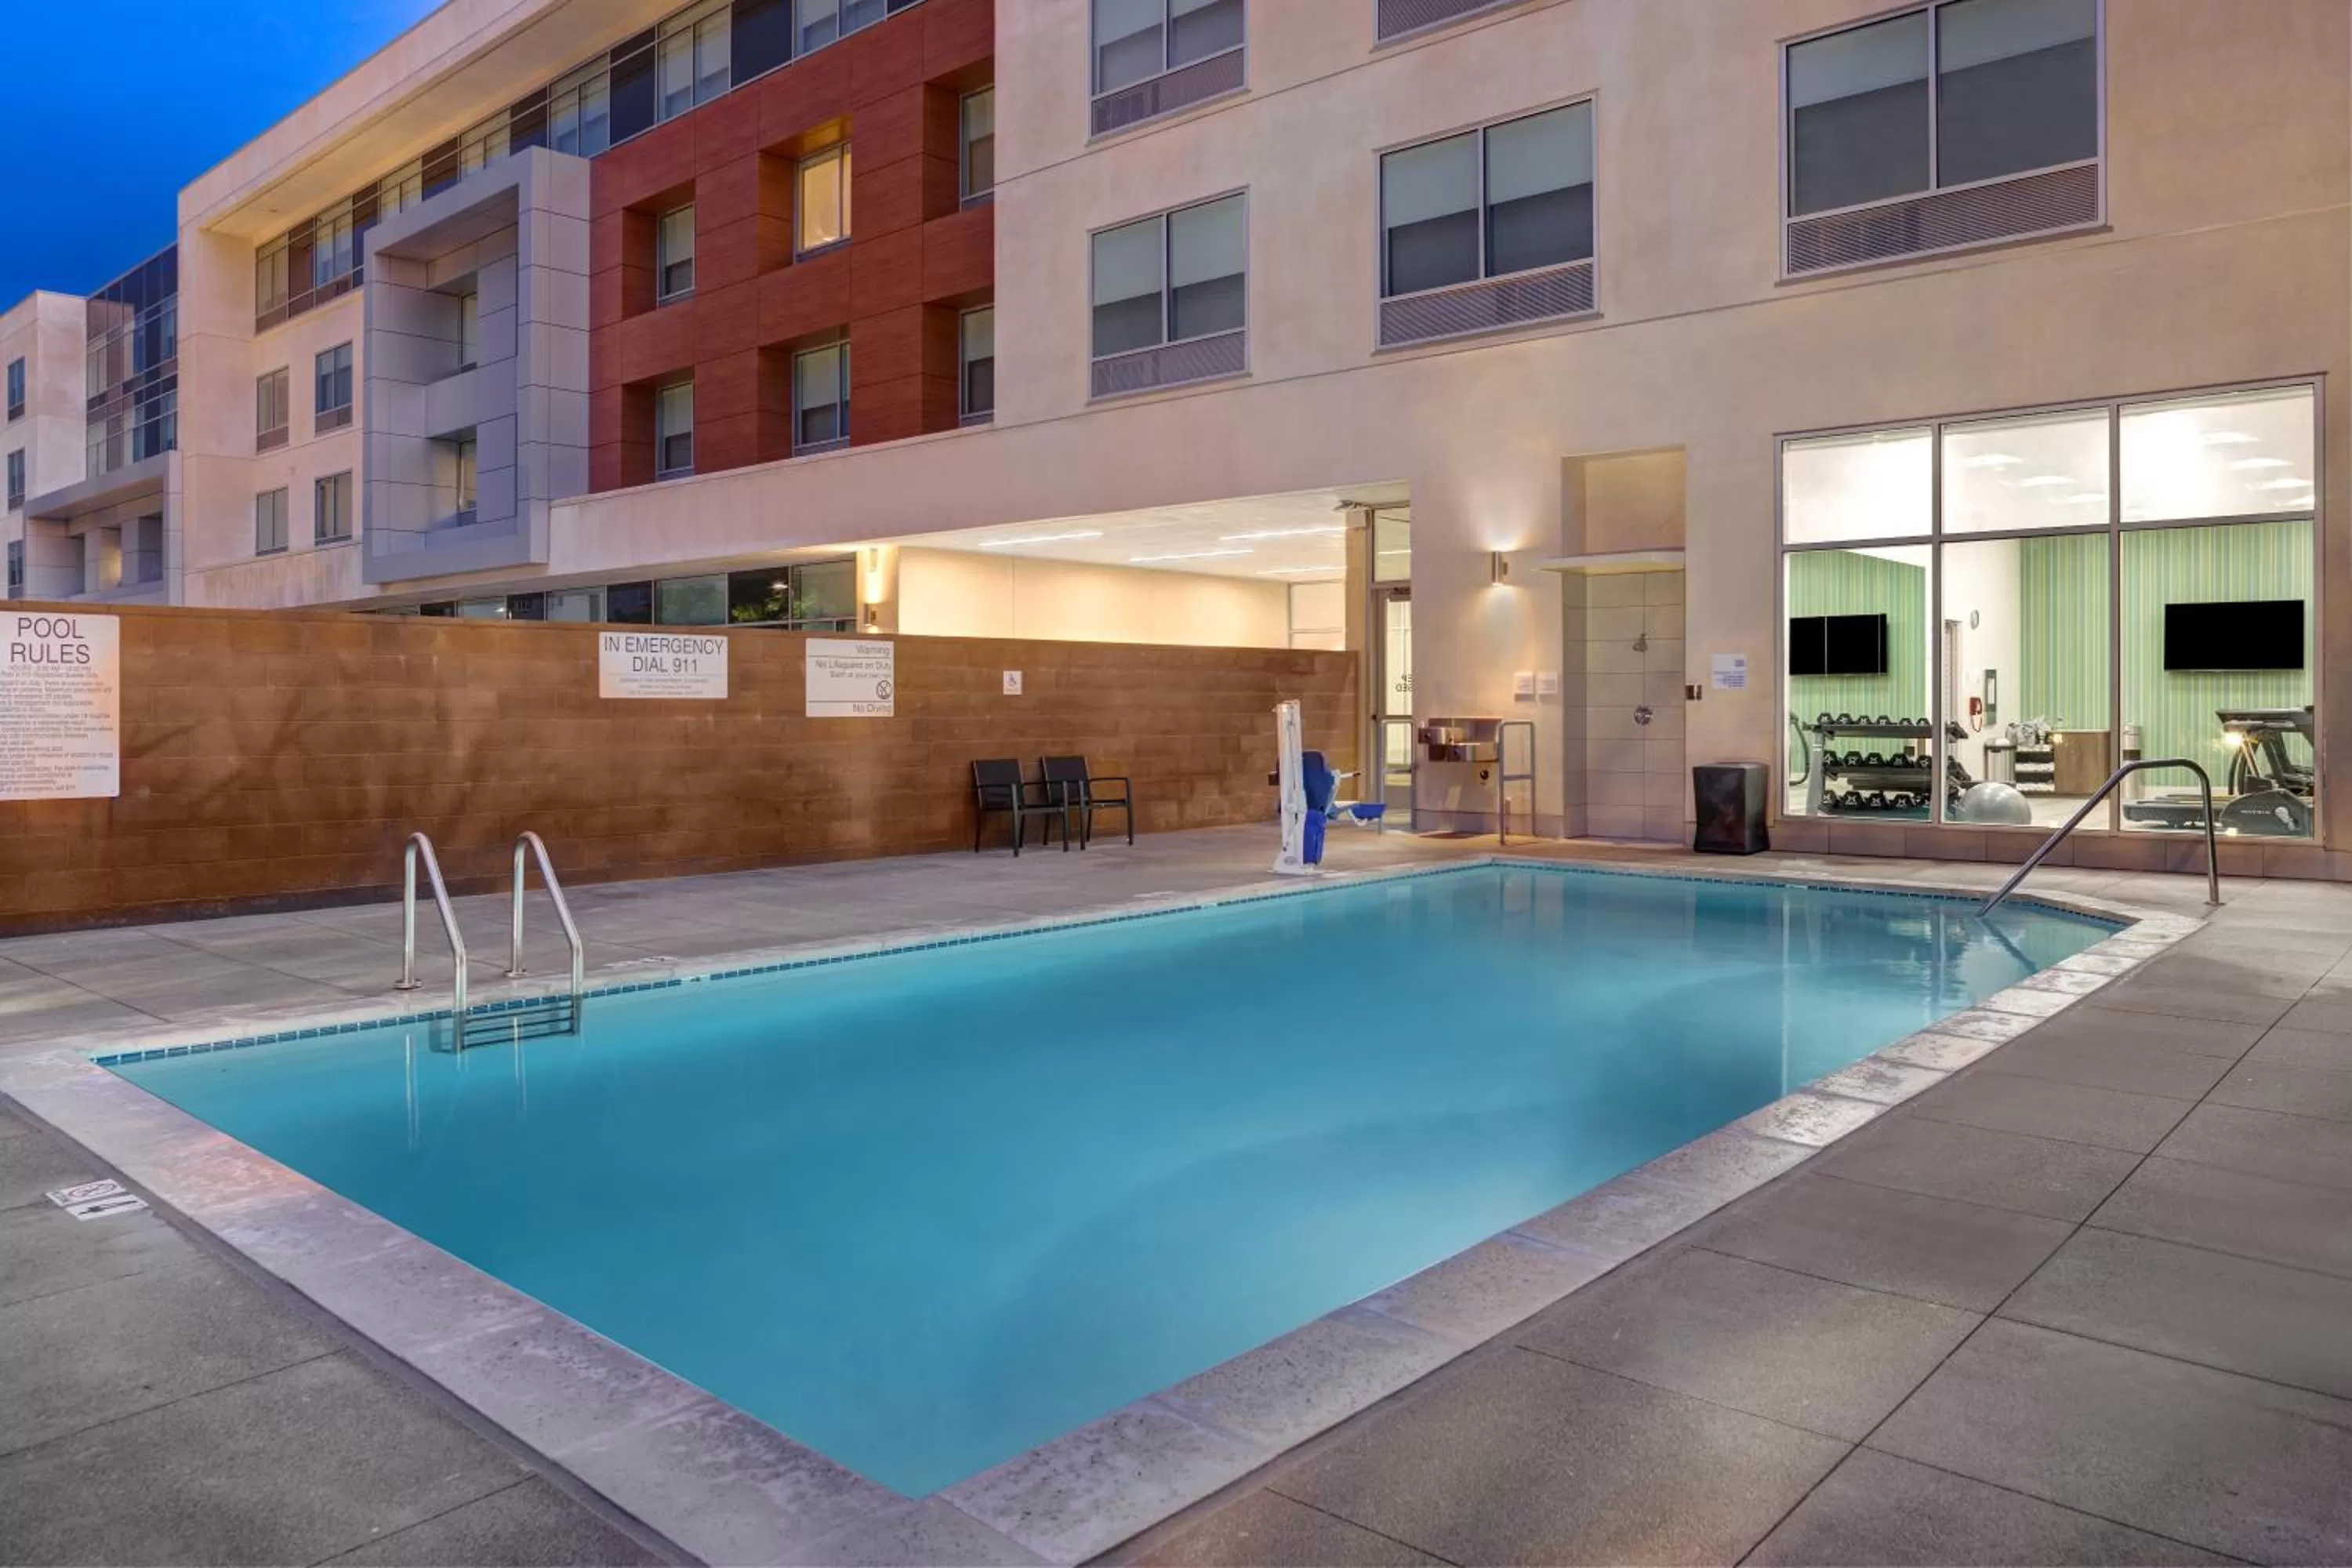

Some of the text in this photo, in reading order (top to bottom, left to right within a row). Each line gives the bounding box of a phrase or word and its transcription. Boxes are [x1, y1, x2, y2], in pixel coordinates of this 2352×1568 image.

[18, 617, 85, 639] POOL
[10, 642, 91, 664] RULES
[604, 636, 724, 655] IN EMERGENCY
[633, 656, 698, 673] DIAL 911
[852, 703, 866, 713] No
